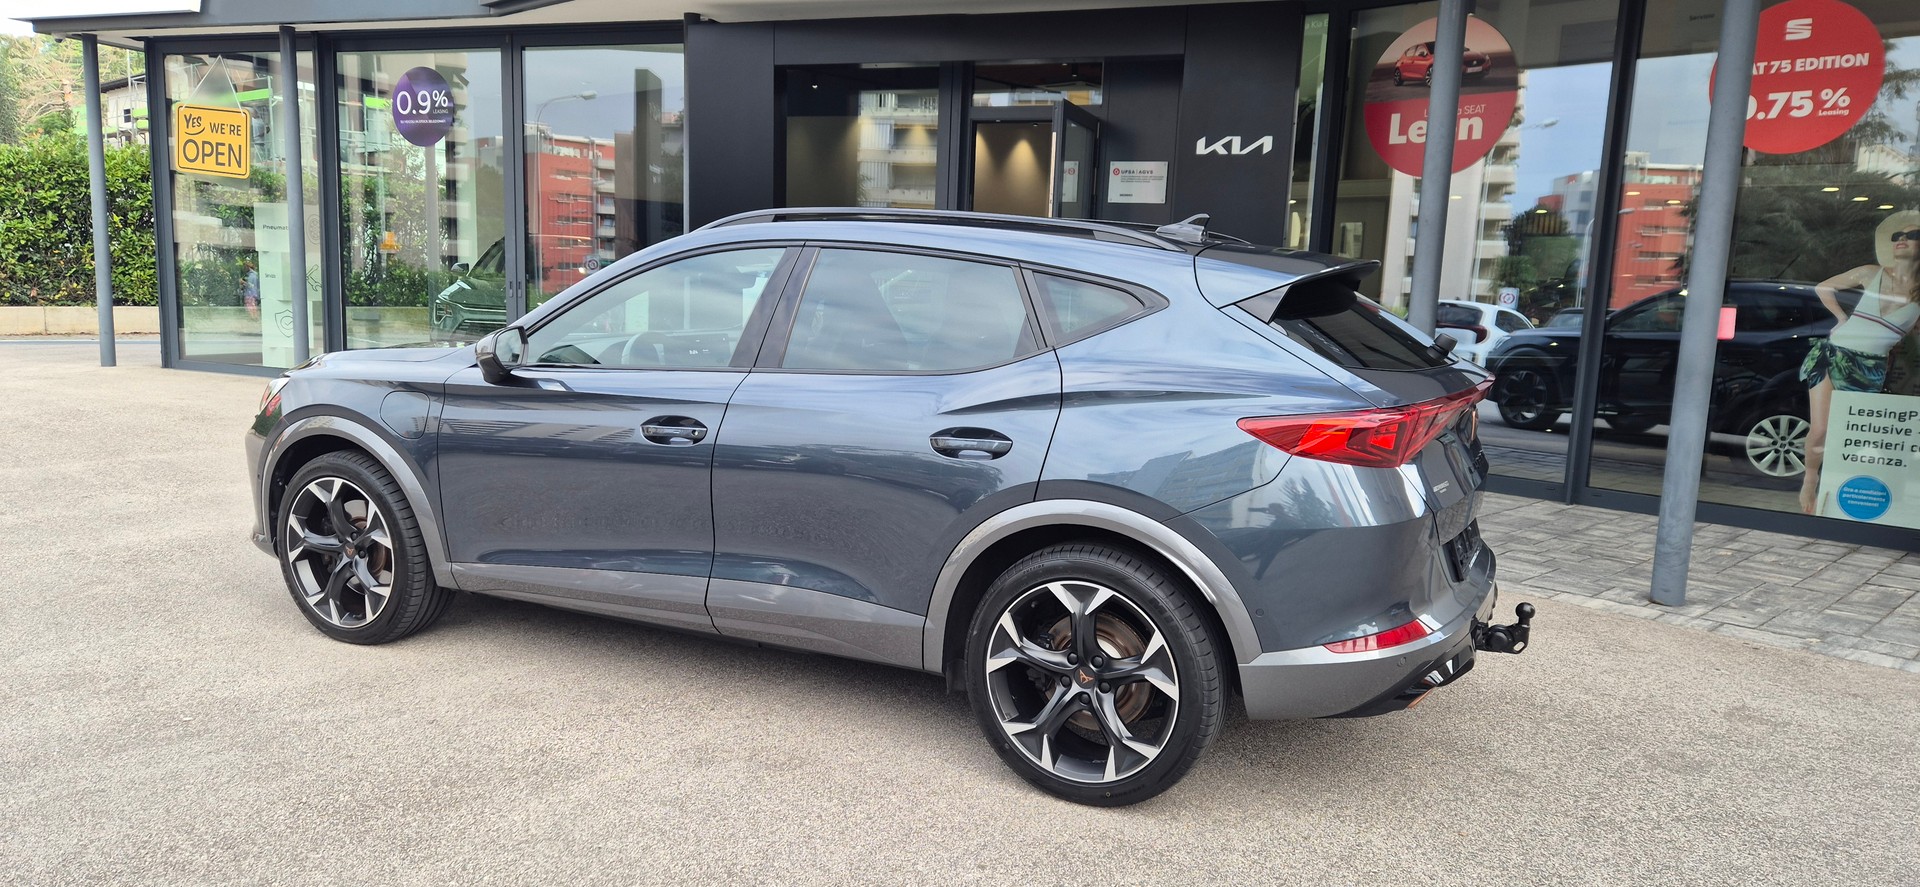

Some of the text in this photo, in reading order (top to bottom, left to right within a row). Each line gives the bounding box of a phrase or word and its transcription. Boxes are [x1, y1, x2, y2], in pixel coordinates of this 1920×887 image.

[1769, 59, 1792, 74] 75
[1795, 52, 1870, 72] EDITION
[1464, 104, 1487, 115] SEAT
[1818, 107, 1849, 117] Leasing
[209, 122, 242, 136] WE'RE
[1389, 112, 1484, 145] Len
[182, 138, 242, 169] OPEN
[1195, 135, 1273, 155] KIA
[1848, 405, 1920, 423] LeasingP
[1846, 420, 1913, 437] inclusive
[1844, 438, 1920, 453] pensieri c
[1842, 453, 1907, 468] vacanza.
